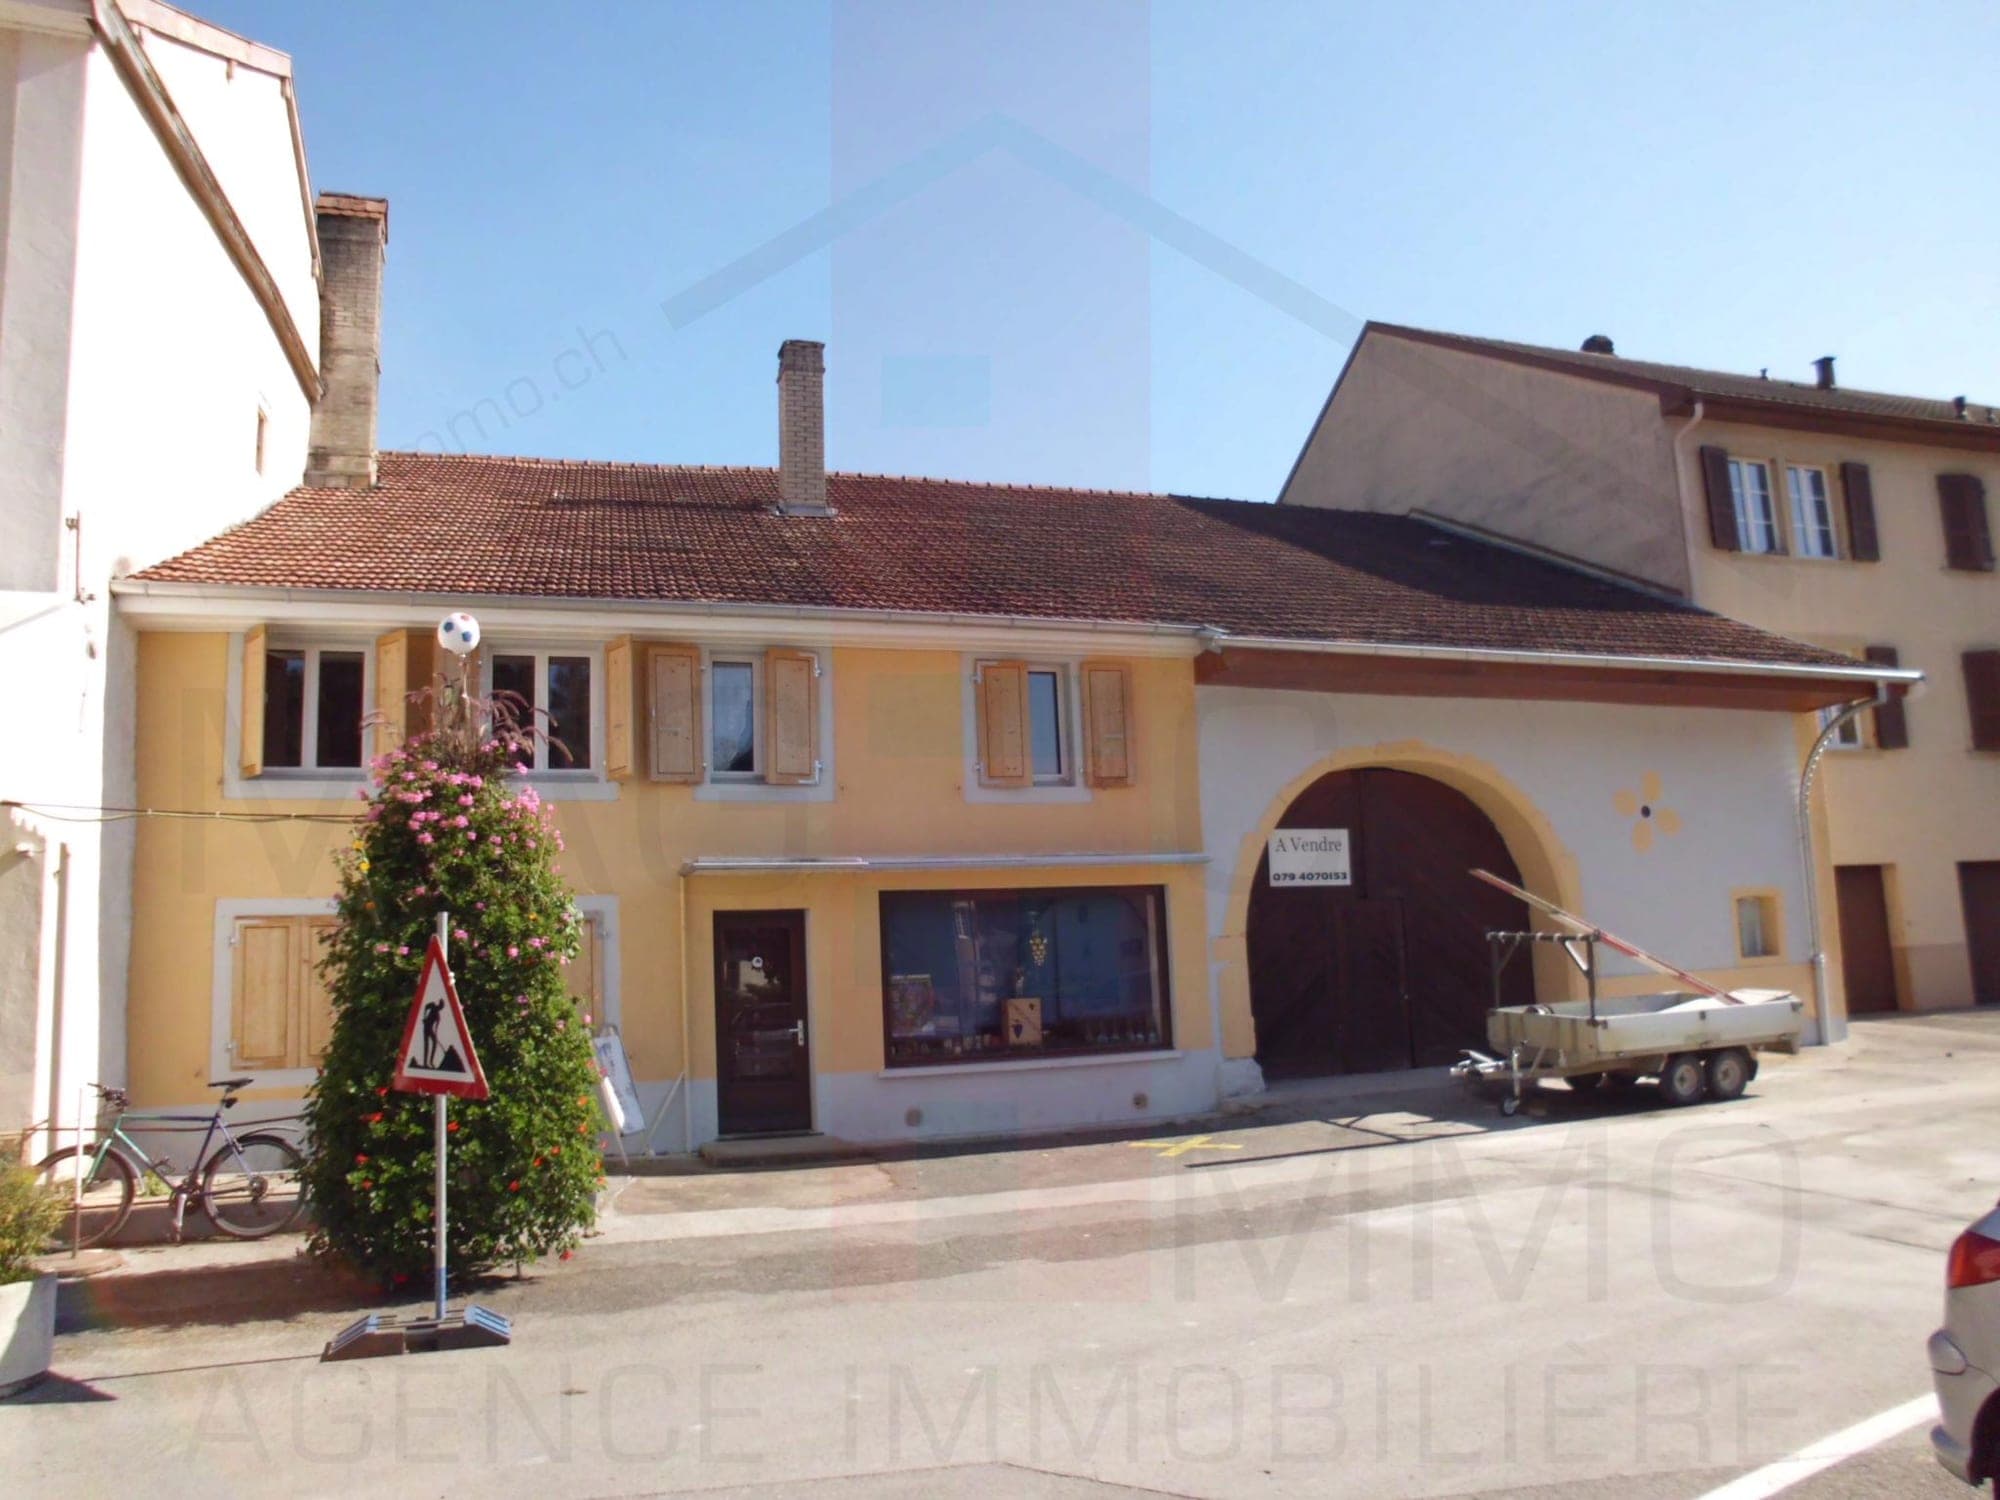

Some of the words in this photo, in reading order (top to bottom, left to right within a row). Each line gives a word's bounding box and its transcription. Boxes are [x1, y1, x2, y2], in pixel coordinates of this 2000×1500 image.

[1275, 837, 1287, 853] A
[1290, 836, 1343, 852] Vendre
[1272, 872, 1296, 882] 079
[1298, 871, 1348, 881] 4070153
